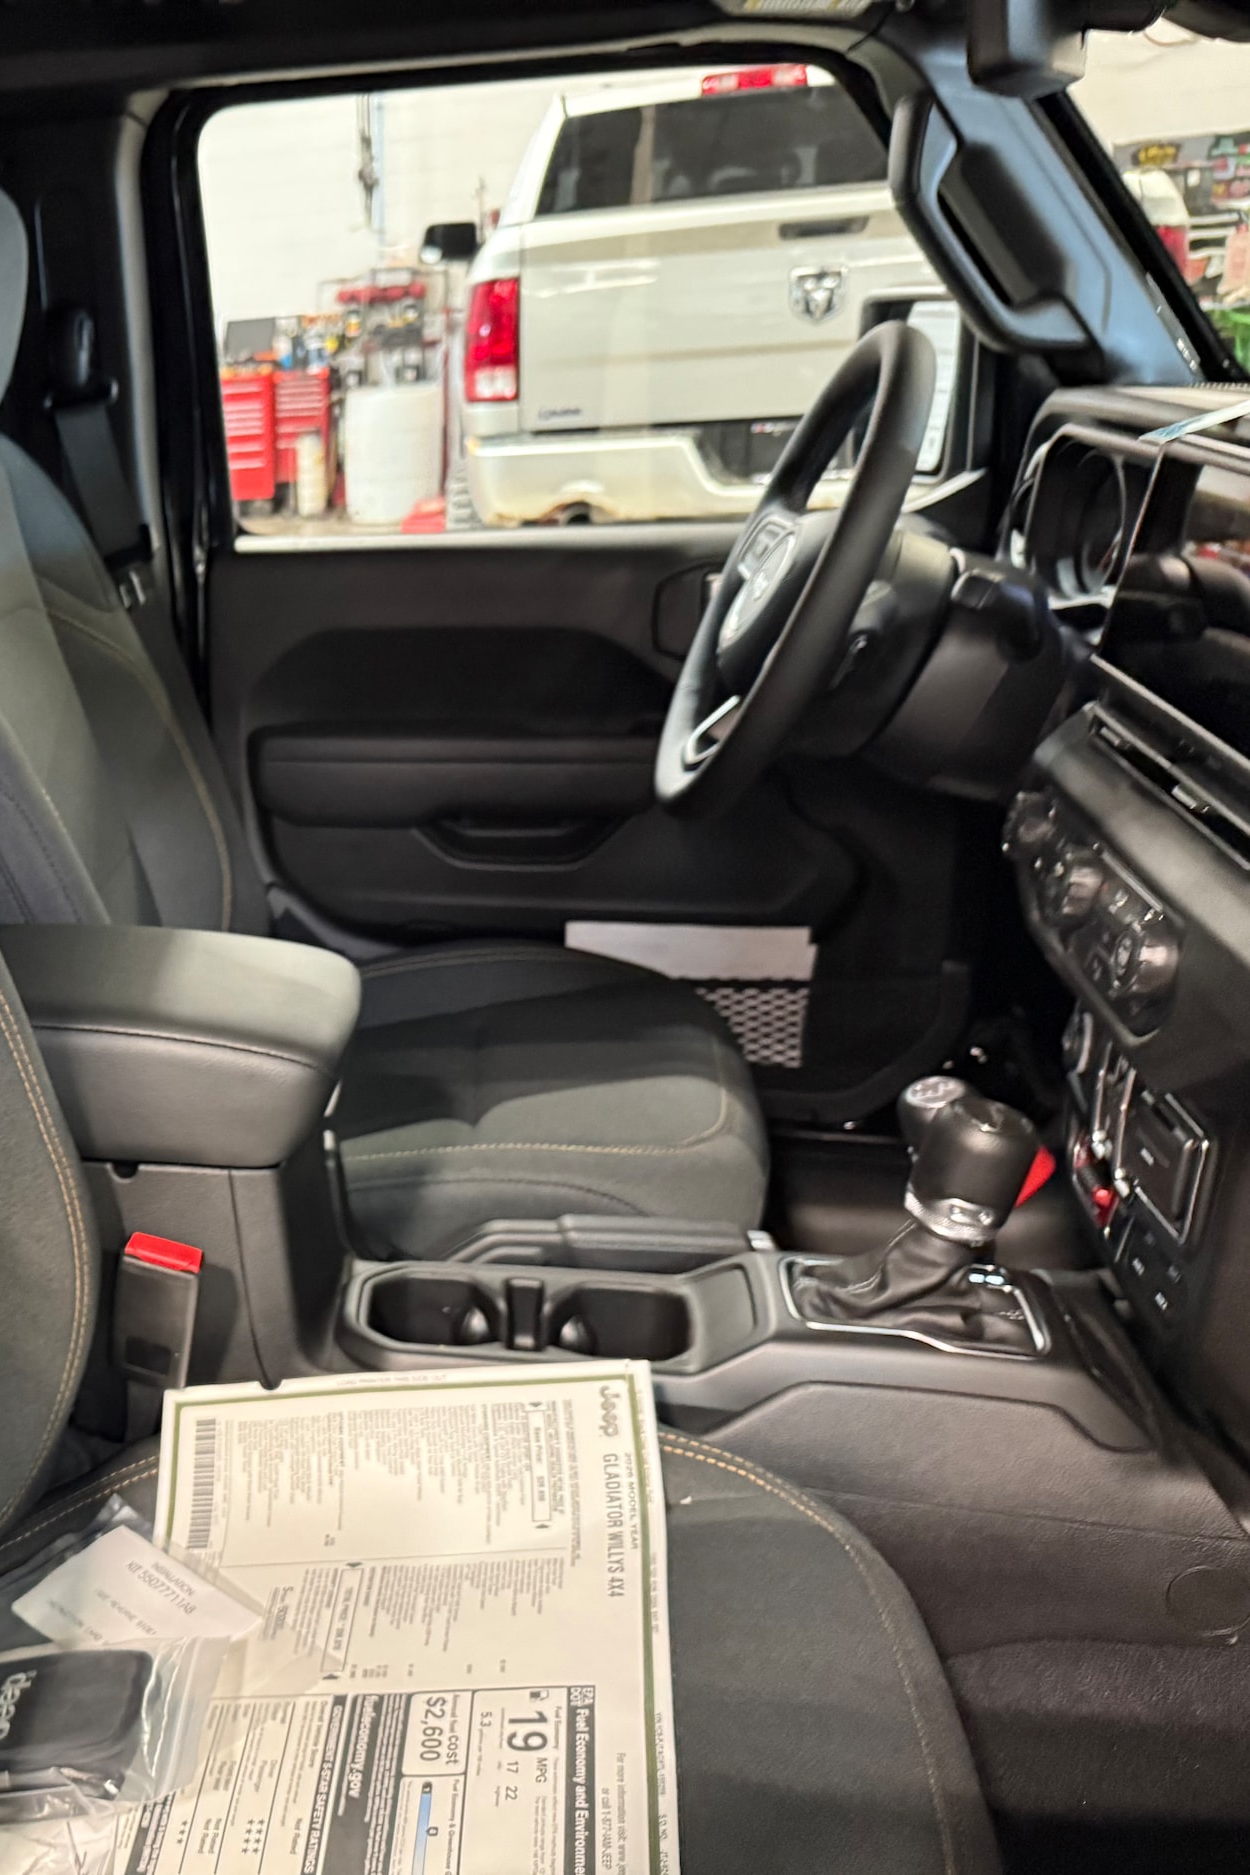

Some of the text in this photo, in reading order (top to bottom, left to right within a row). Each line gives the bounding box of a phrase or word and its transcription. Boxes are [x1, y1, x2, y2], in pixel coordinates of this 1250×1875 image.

[599, 1386, 621, 1438] Jeep
[627, 1481, 636, 1520] MODEL
[603, 1453, 625, 1598] GLADIATOR WILLYS 4X4
[126, 1559, 143, 1574] KIT
[569, 1688, 581, 1707] DOT
[582, 1688, 594, 1704] EPA
[419, 1696, 447, 1761] $2,600
[480, 1711, 492, 1727] 5.3
[348, 1695, 379, 1798] fueleconomy.gov
[446, 1735, 460, 1765] cost
[506, 1710, 548, 1752] 19
[535, 1757, 547, 1783] MPG
[617, 1752, 626, 1763] For
[304, 1705, 343, 1873] GOVERNMENT 5-STAR SAFETY RATINGS
[505, 1761, 519, 1801] 17 22
[572, 1709, 590, 1875] Fuel Economy and Environme
[449, 1793, 458, 1821] Economy
[617, 1784, 626, 1823] information
[290, 1818, 303, 1855] Not Rated
[446, 1830, 455, 1869] Greenhouse
